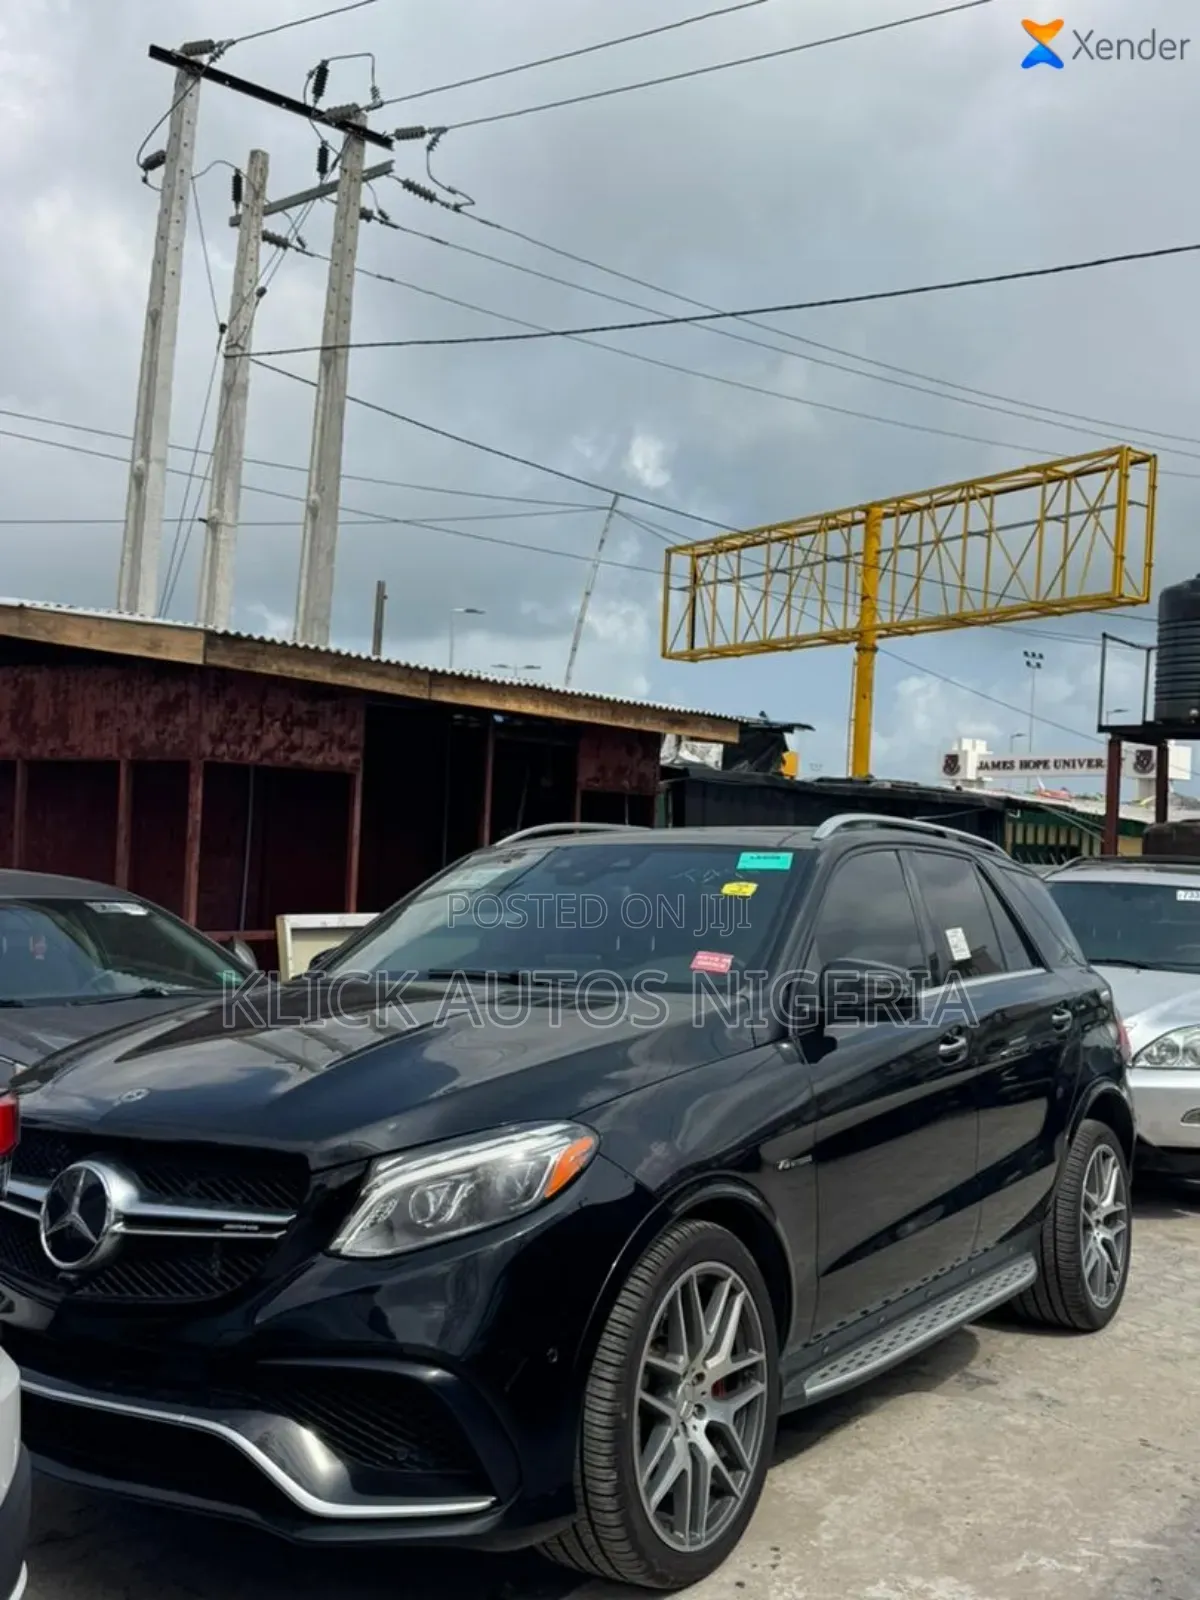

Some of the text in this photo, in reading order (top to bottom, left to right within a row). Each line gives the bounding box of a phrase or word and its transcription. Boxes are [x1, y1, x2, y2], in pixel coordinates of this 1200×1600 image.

[977, 757, 1106, 771] JAMES HOPE UNIVER
